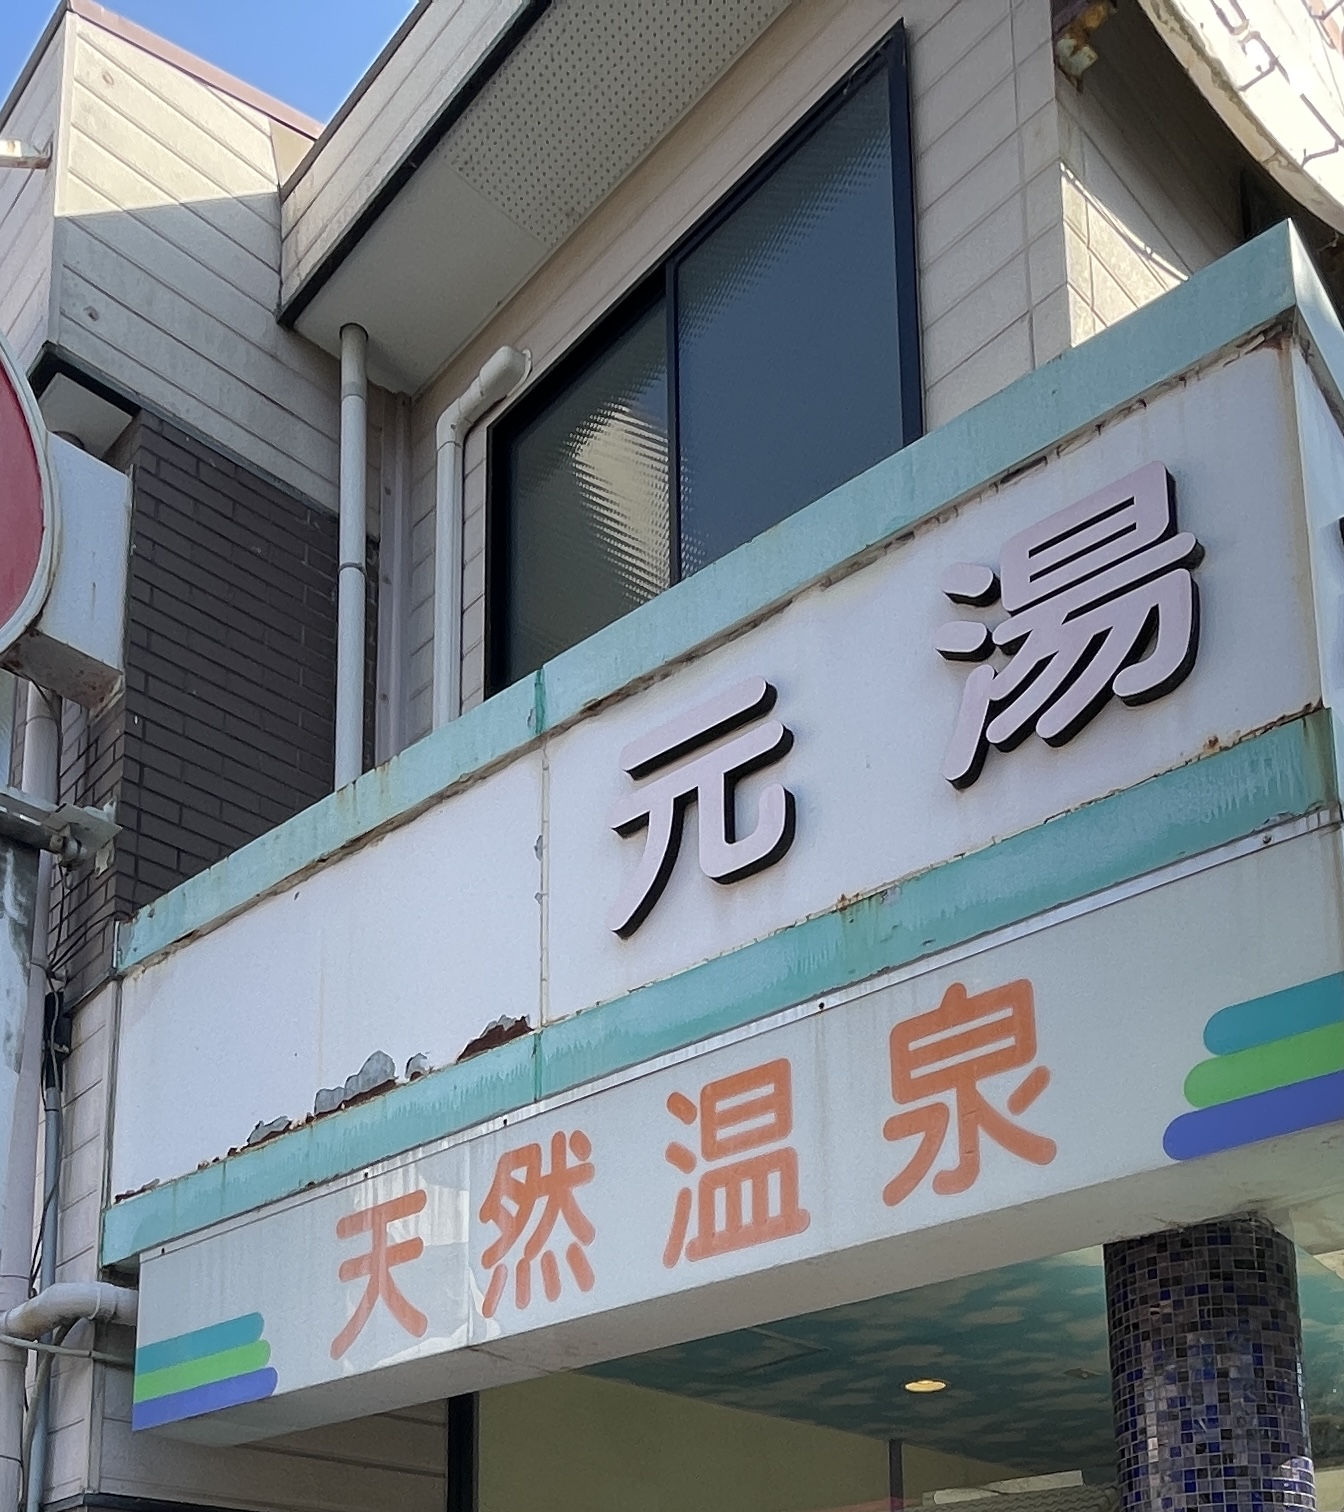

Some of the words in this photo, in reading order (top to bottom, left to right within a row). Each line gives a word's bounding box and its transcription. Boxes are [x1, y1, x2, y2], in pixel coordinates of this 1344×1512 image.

[608, 459, 1205, 939] 元湯
[329, 977, 1058, 1362] 天然温泉
